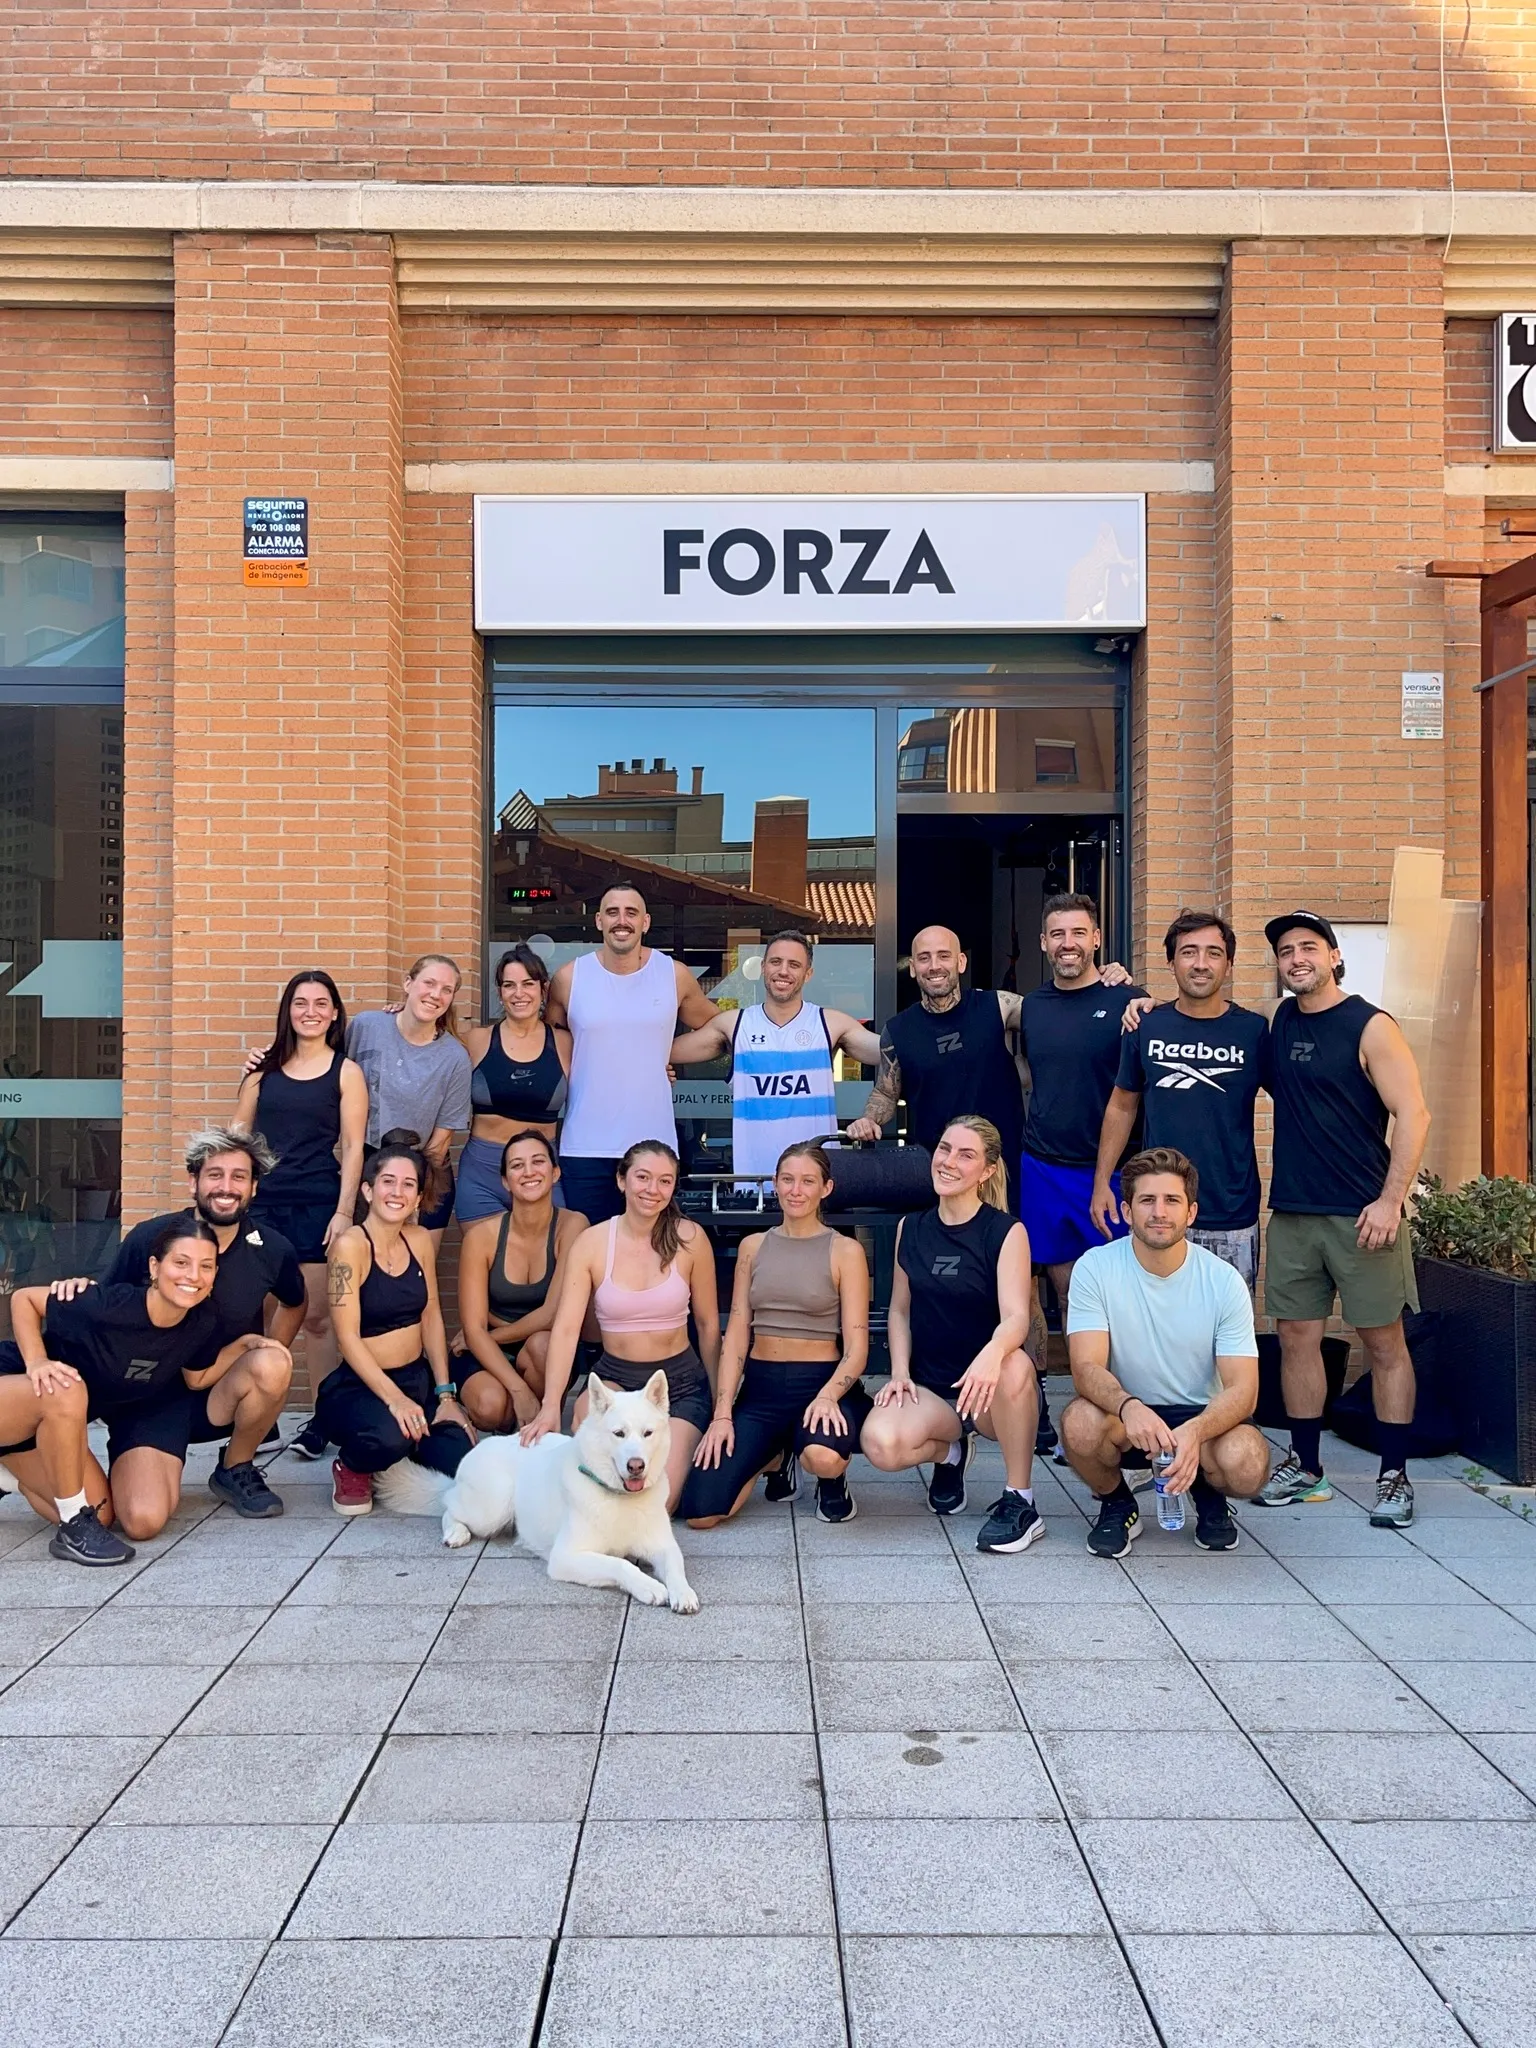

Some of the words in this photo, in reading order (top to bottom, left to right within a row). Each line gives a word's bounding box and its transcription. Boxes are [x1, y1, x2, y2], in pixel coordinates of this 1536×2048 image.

[247, 501, 305, 512] segurma
[251, 523, 267, 532] 902
[269, 523, 283, 532] 108
[248, 536, 304, 547] ALARMA
[248, 562, 293, 571] Grabación
[663, 528, 956, 595] FORZA
[262, 572, 303, 580] imágenes
[1147, 1039, 1244, 1064] Reebok
[750, 1074, 811, 1096] VISA
[700, 1094, 708, 1104] Y
